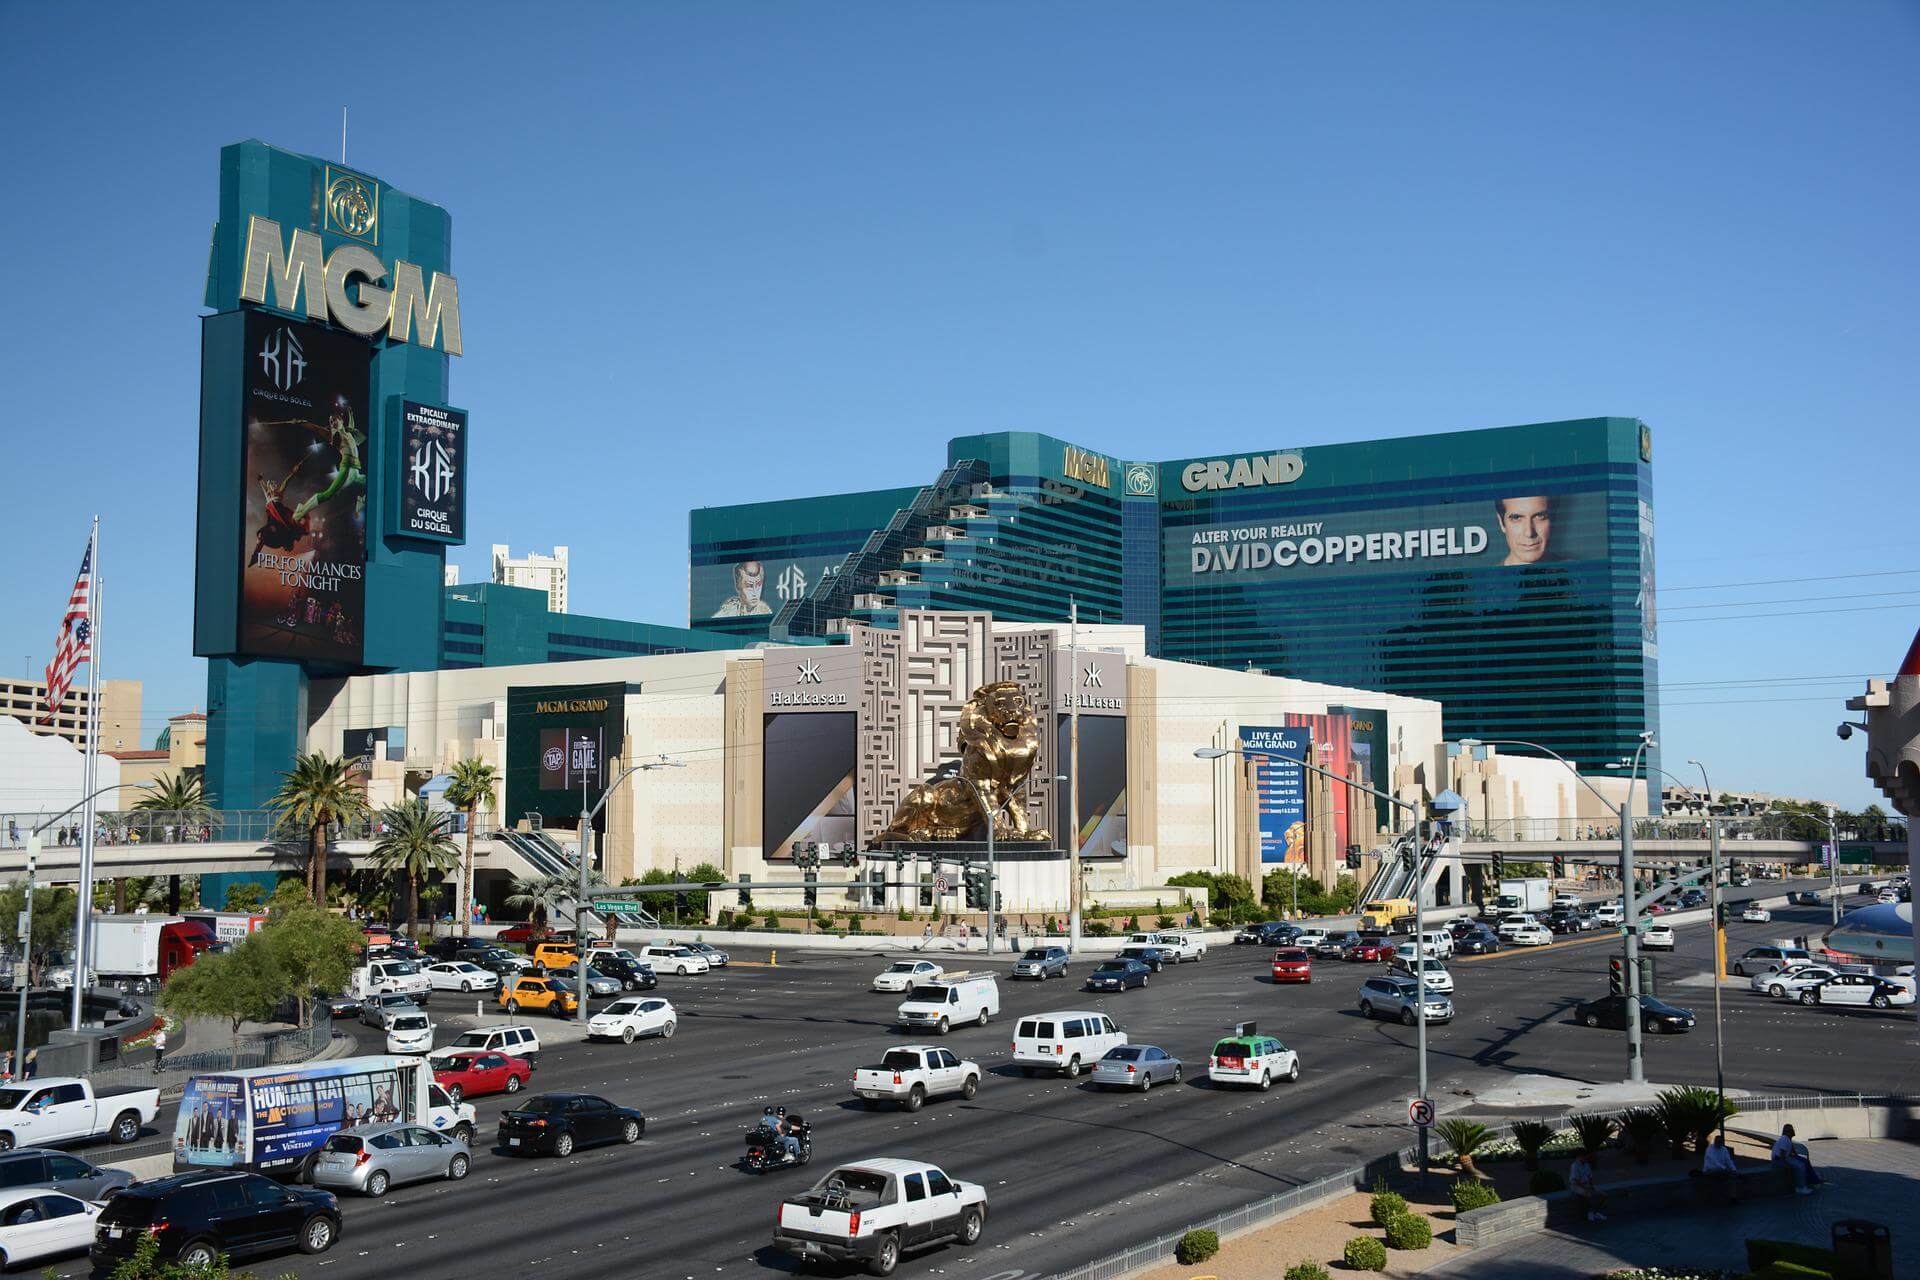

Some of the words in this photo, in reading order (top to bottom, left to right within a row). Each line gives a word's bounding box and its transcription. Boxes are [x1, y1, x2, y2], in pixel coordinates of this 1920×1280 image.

[240, 215, 462, 357] MGM
[419, 406, 449, 421] EPICALLY
[406, 412, 460, 432] EXTRAORDINARY
[1063, 446, 1111, 489] MGM
[1181, 453, 1305, 493] GRAND
[416, 507, 449, 523] CIRQUE
[410, 518, 429, 529] DU
[430, 519, 454, 535] SOLEIL
[1191, 528, 1230, 545] ALTER
[1230, 526, 1268, 542] YOUR
[1270, 522, 1324, 538] REALITY
[256, 552, 362, 580] PERFORMANCES
[279, 571, 341, 593] TONIGHT
[536, 700, 568, 713] MGM
[570, 698, 608, 712] GRAND
[771, 691, 848, 706] Hakkasan
[1251, 731, 1270, 740] LIVE
[1271, 732, 1284, 740] AT
[1242, 740, 1264, 749] MGM
[1264, 740, 1297, 749] GRAND
[546, 754, 561, 766] TAP
[572, 749, 597, 770] GAME
[607, 904, 623, 912] Vegas
[219, 927, 238, 936] TICKETS
[253, 1082, 313, 1110] HUMAN
[256, 1111, 268, 1119] THE
